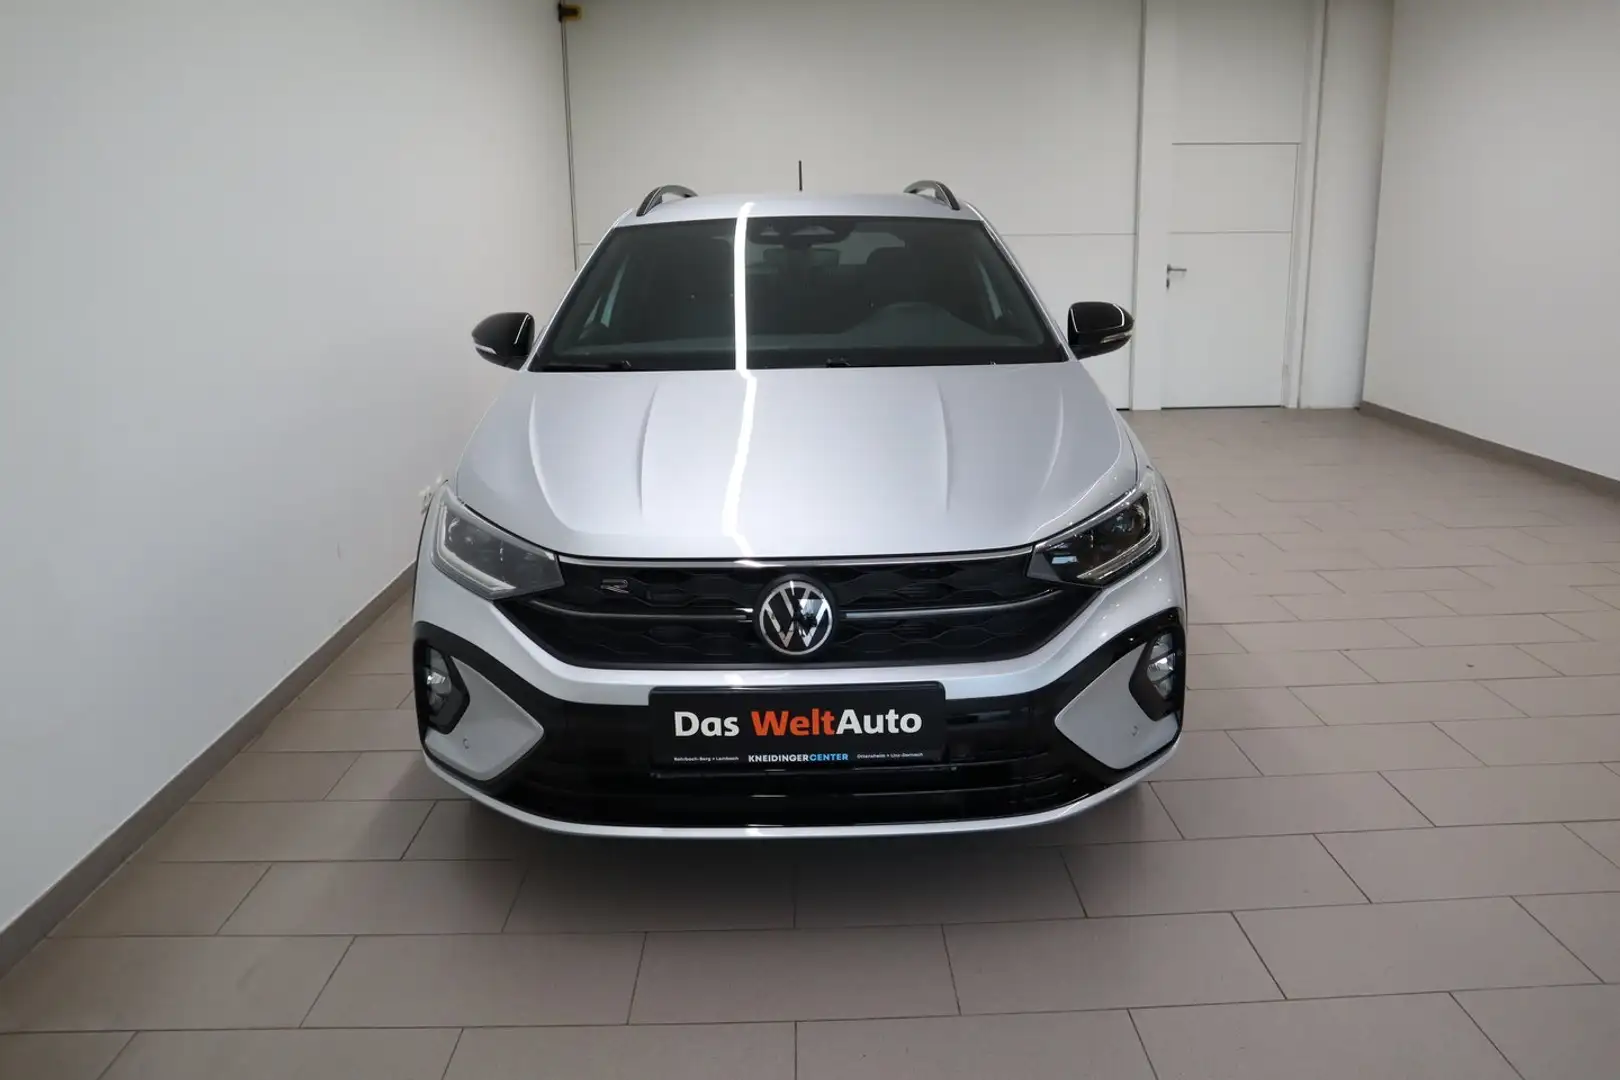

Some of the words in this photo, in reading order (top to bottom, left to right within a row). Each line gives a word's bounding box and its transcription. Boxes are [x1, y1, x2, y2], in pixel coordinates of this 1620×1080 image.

[674, 711, 740, 737] Das
[751, 708, 923, 737] WeltAuto
[747, 752, 849, 763] KNEIDINGERCENTER
